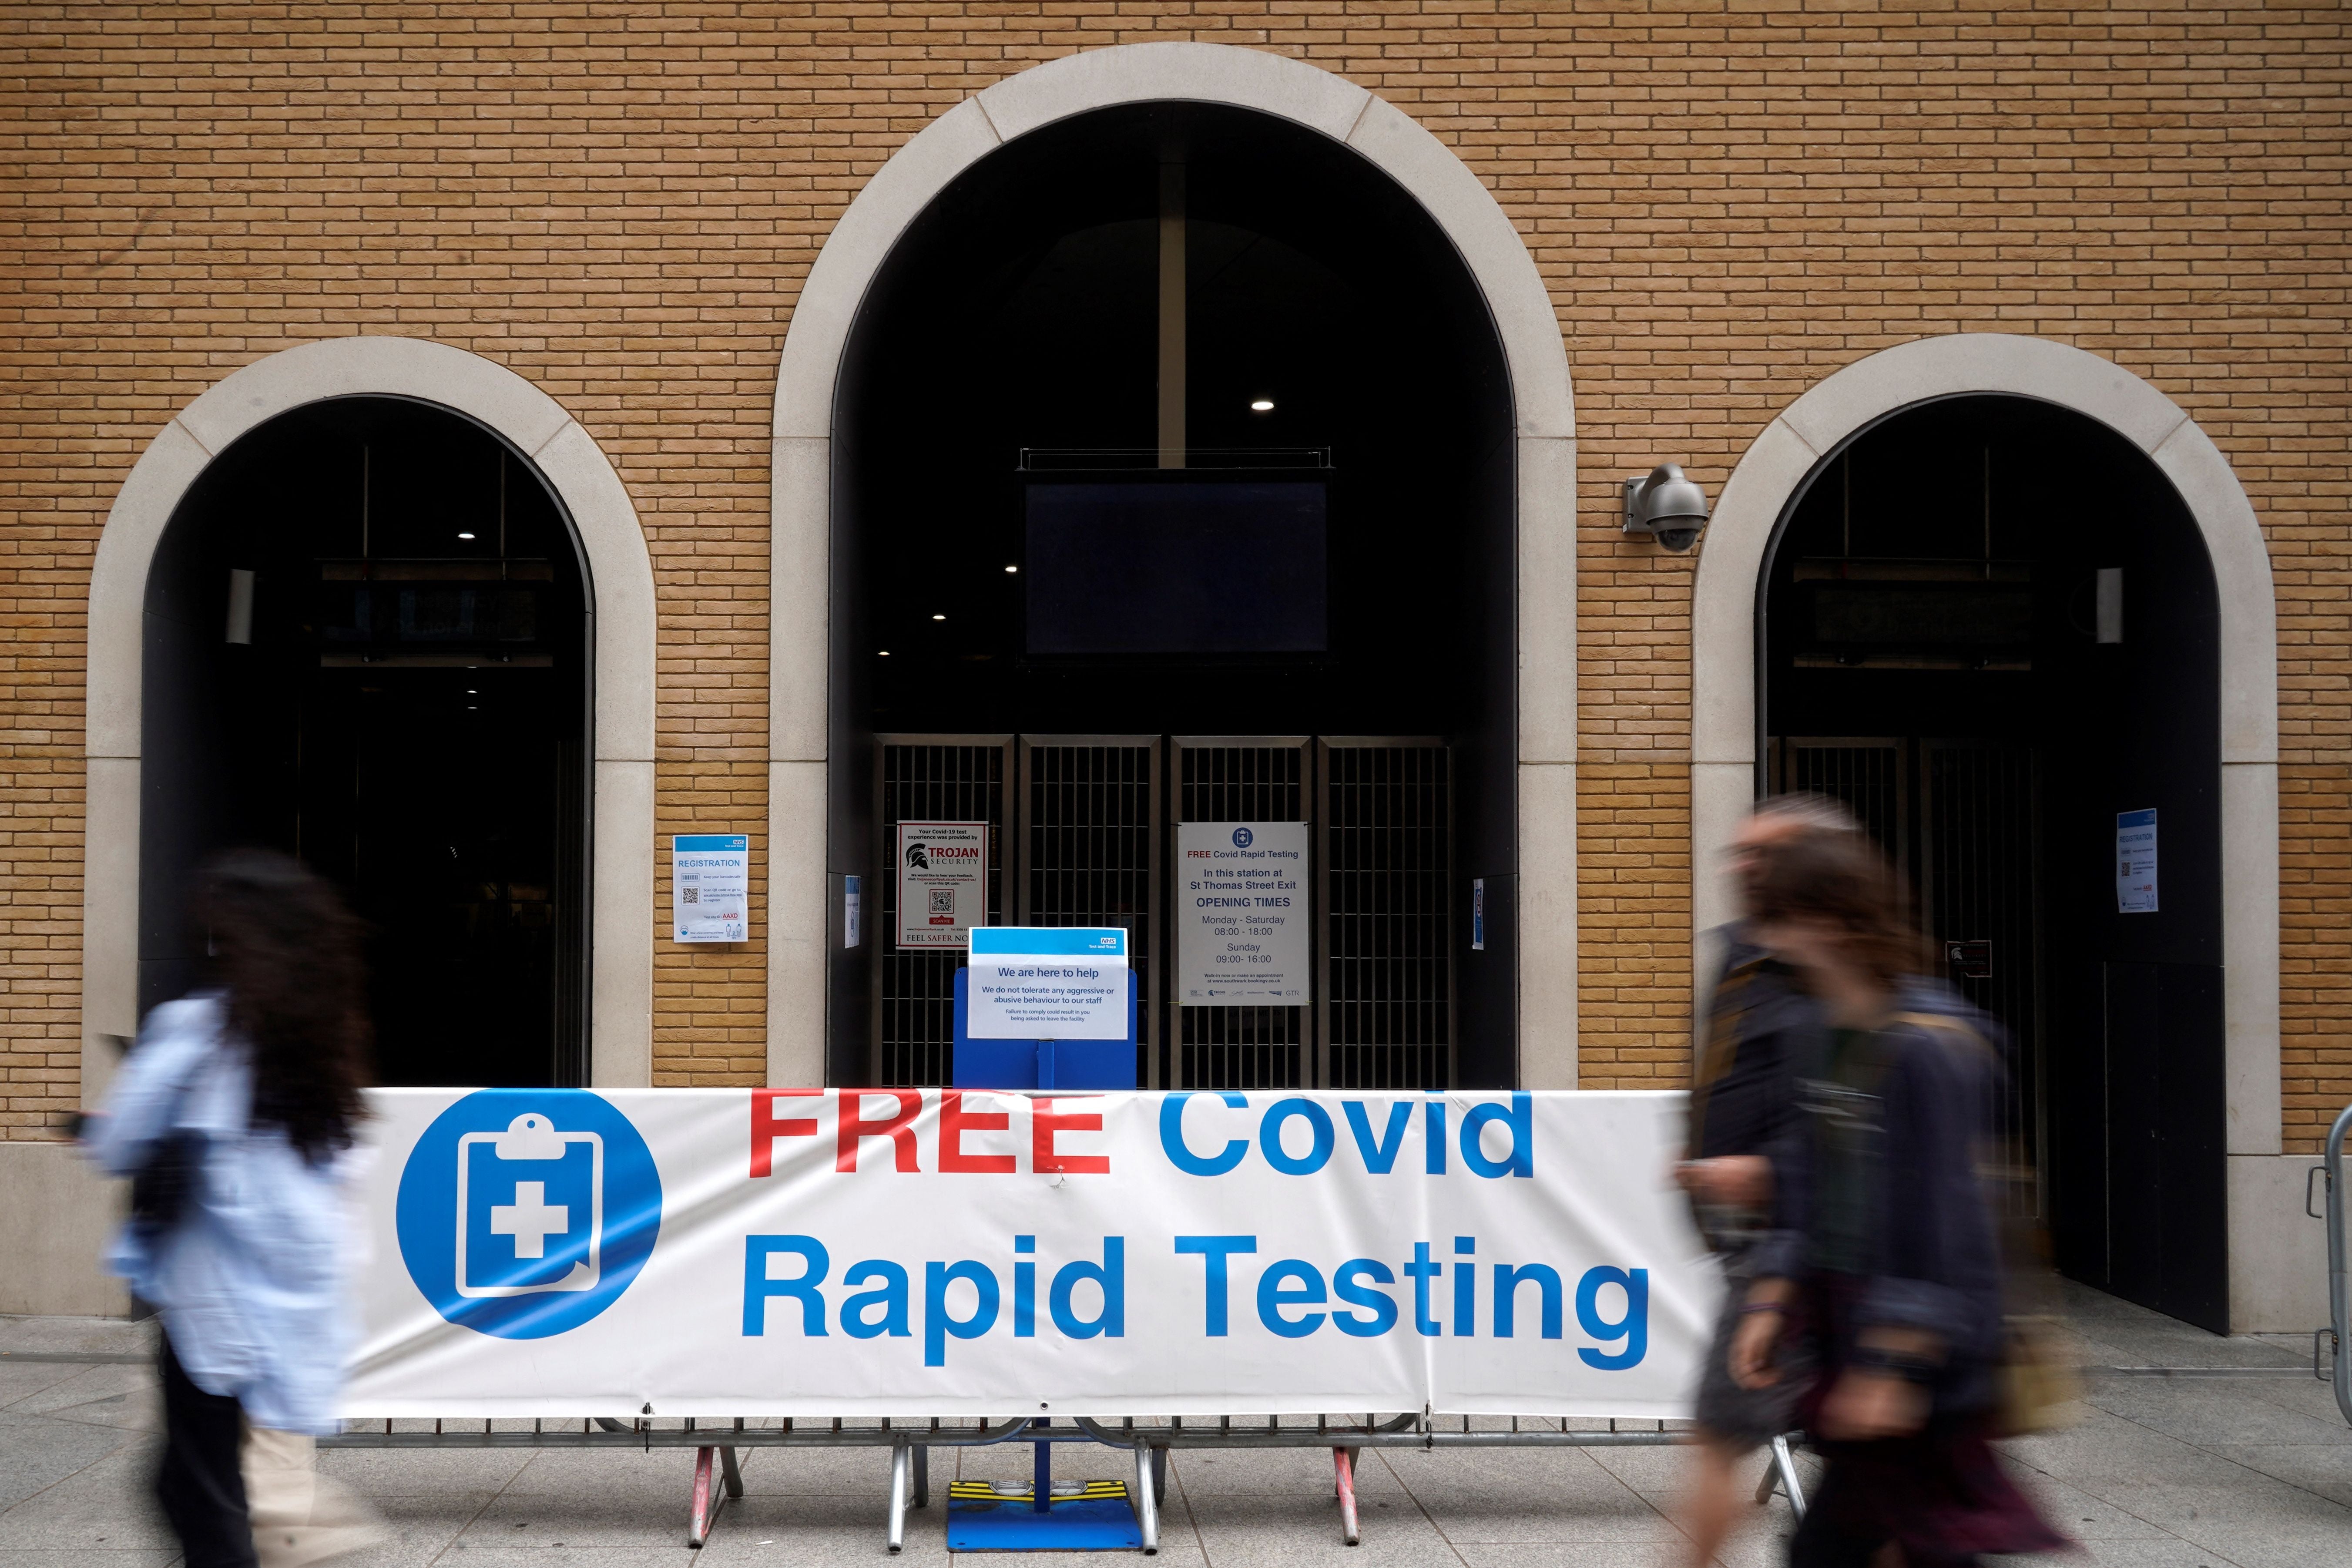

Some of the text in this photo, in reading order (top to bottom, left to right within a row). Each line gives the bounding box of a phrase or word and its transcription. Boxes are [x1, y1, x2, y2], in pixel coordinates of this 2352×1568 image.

[2119, 833, 2153, 843] REGISTRATION
[928, 848, 978, 857] TROJAN
[1241, 850, 1265, 859] Rapid
[1267, 850, 1298, 859] Testing
[1215, 869, 1234, 877] this
[1237, 869, 1270, 877] station
[1191, 881, 1296, 890] St Thomas Street Exit
[1197, 897, 1290, 907] OPENING TIMES
[1202, 916, 1237, 924] Monday
[1246, 916, 1285, 924] Saturday
[1227, 943, 1260, 952] Sunday
[998, 967, 1015, 977] We
[1037, 967, 1060, 977] here
[1062, 969, 1074, 977] to
[1077, 968, 1099, 979] help
[1067, 987, 1104, 996] aggressive
[749, 1088, 1533, 1179] FREE Covid
[742, 1235, 1649, 1370] Rapid Testing
